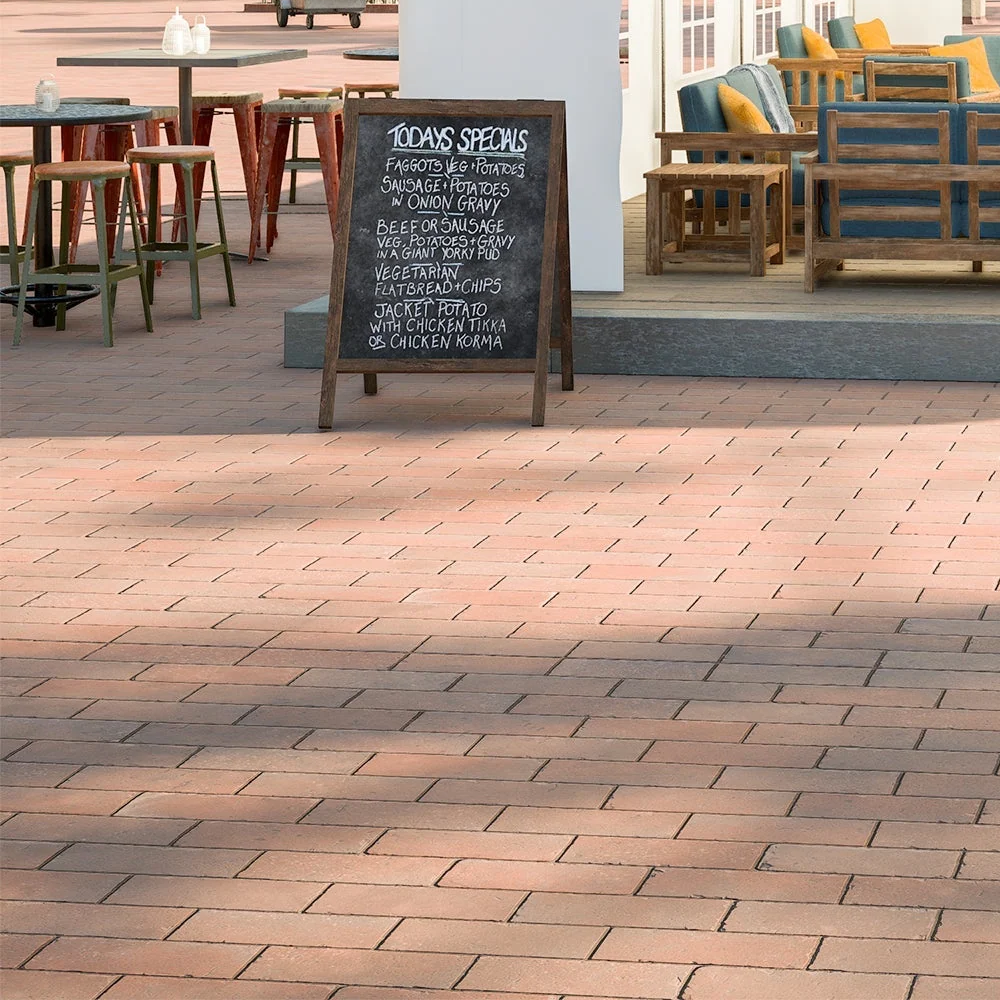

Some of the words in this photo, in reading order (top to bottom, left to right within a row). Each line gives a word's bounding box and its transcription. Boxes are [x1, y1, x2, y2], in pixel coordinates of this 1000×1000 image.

[387, 122, 455, 150] TODAYS
[457, 126, 528, 152] SPECIALS
[386, 157, 443, 176] FAGGOTS
[446, 156, 468, 174] VEG
[381, 176, 441, 195] SAUSAGE
[450, 178, 510, 198] POTATOES
[392, 194, 404, 207] IN
[408, 193, 454, 210] ONION
[458, 195, 501, 217] GRAVY
[377, 219, 419, 235] BEEF
[421, 218, 438, 233] OR
[441, 217, 505, 234] SAUSAGE
[410, 234, 468, 248] POTATOES
[477, 234, 516, 250] GRAVY
[377, 250, 388, 259] IN
[389, 249, 399, 260] A
[401, 246, 437, 260] GIANT
[442, 247, 475, 260] YORKY
[478, 247, 500, 260] PUD
[375, 262, 460, 281] VEGETARIAN
[375, 281, 453, 297] FLATBREAD
[374, 301, 432, 321] JACKET
[438, 301, 488, 318] POTATO
[370, 319, 401, 333] WITH
[406, 317, 465, 334] CHICKEN
[468, 317, 506, 334] TIKKA
[369, 335, 386, 348] OR
[390, 333, 452, 350] CHICKEN
[456, 333, 503, 351] KORMA
